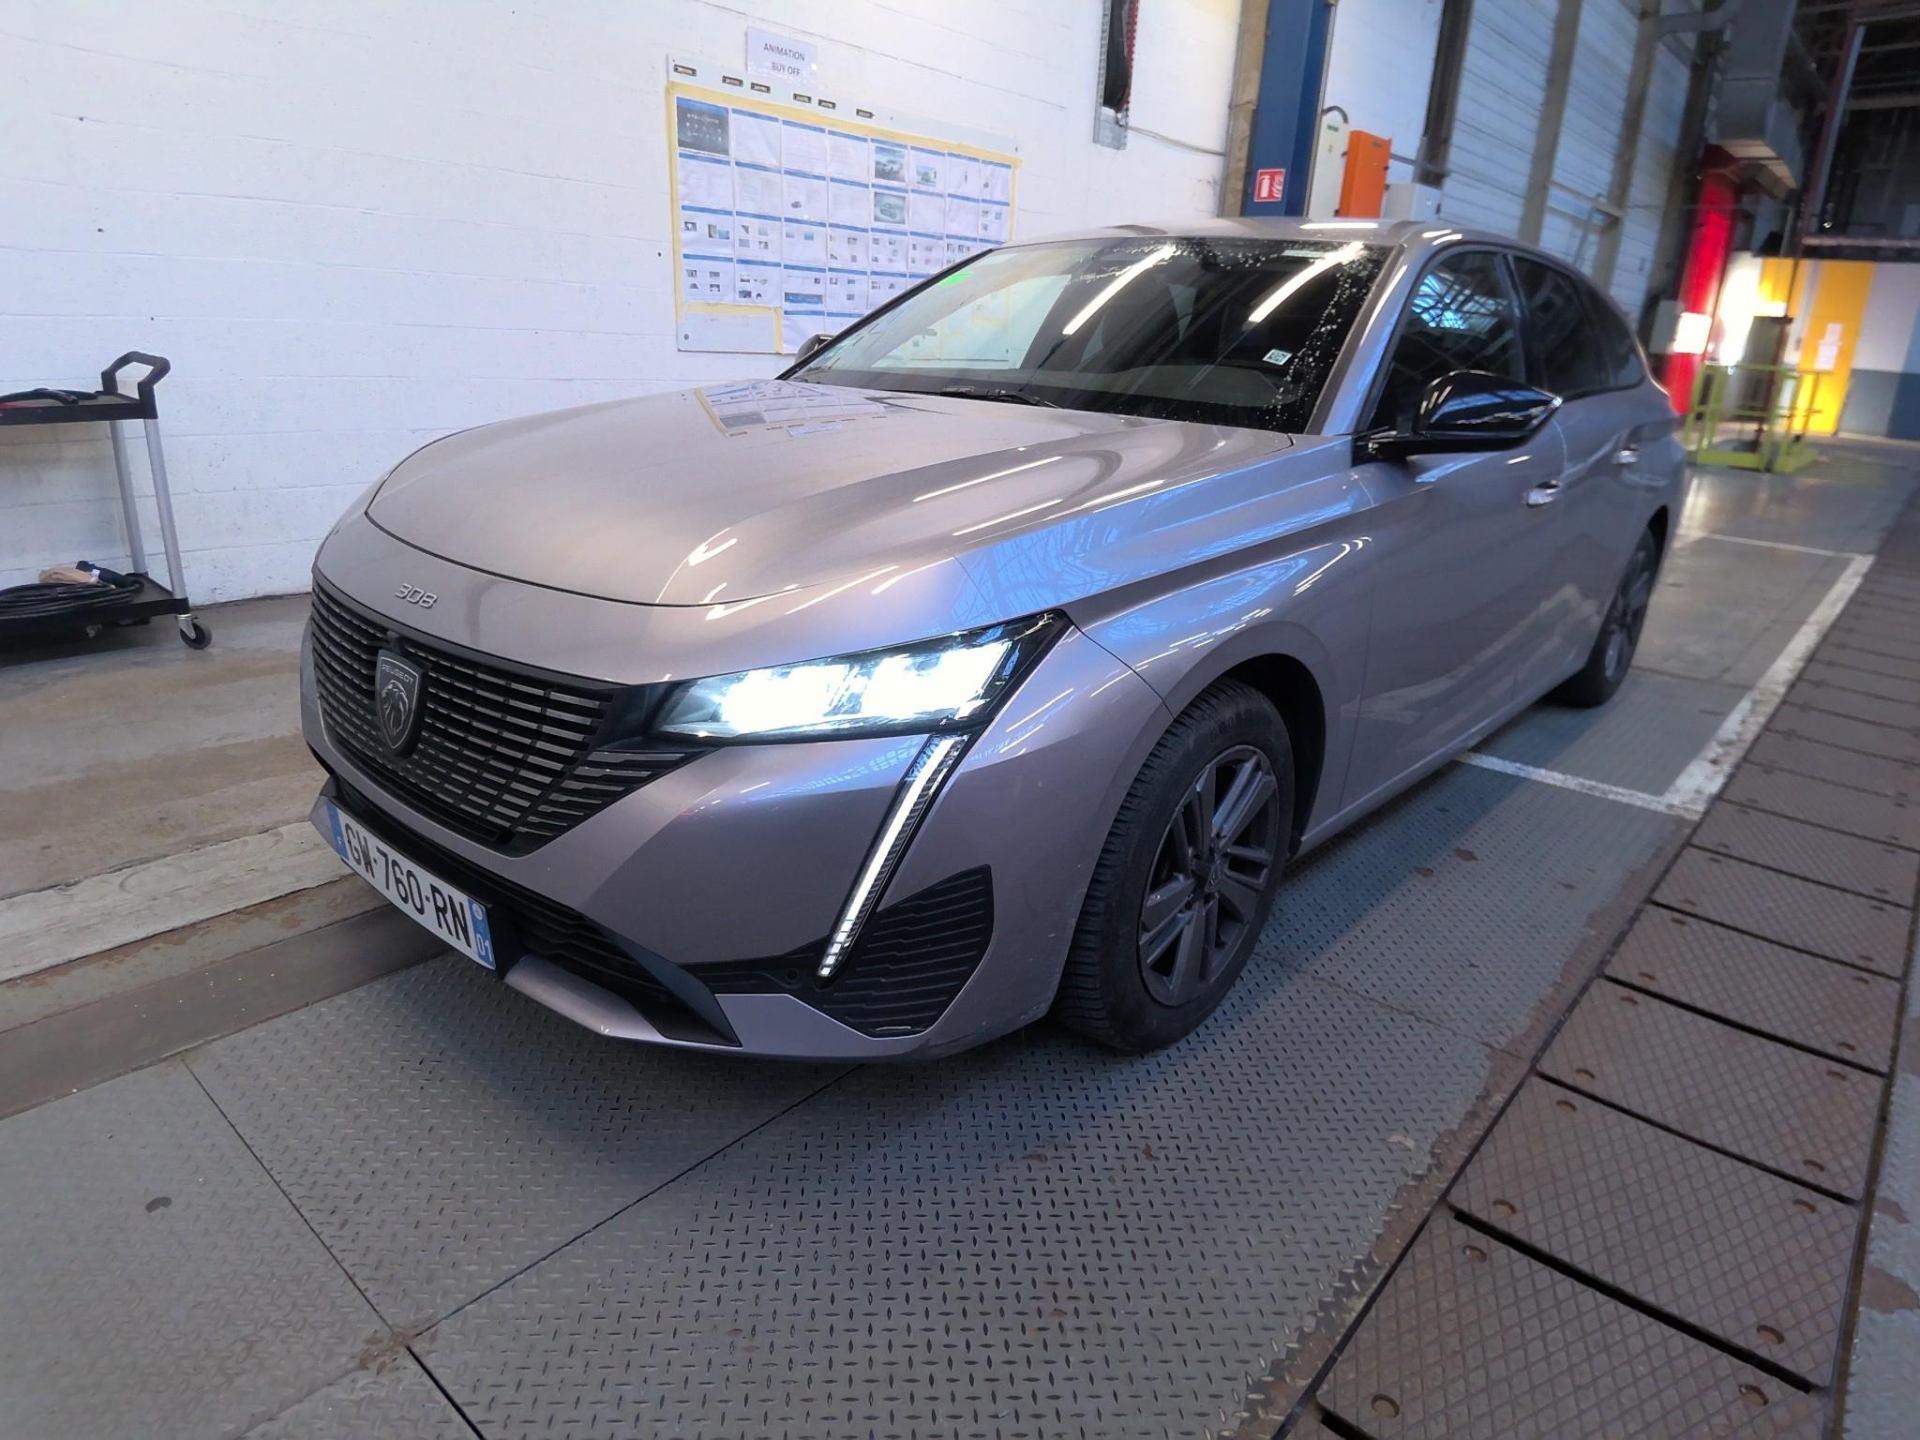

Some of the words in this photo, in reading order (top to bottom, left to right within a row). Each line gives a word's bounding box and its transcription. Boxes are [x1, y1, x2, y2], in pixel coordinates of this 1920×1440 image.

[764, 43, 805, 61] ANIMATION
[772, 62, 785, 73] BUY
[787, 66, 801, 75] OFF
[395, 583, 438, 608] 308
[476, 934, 493, 962] 01
